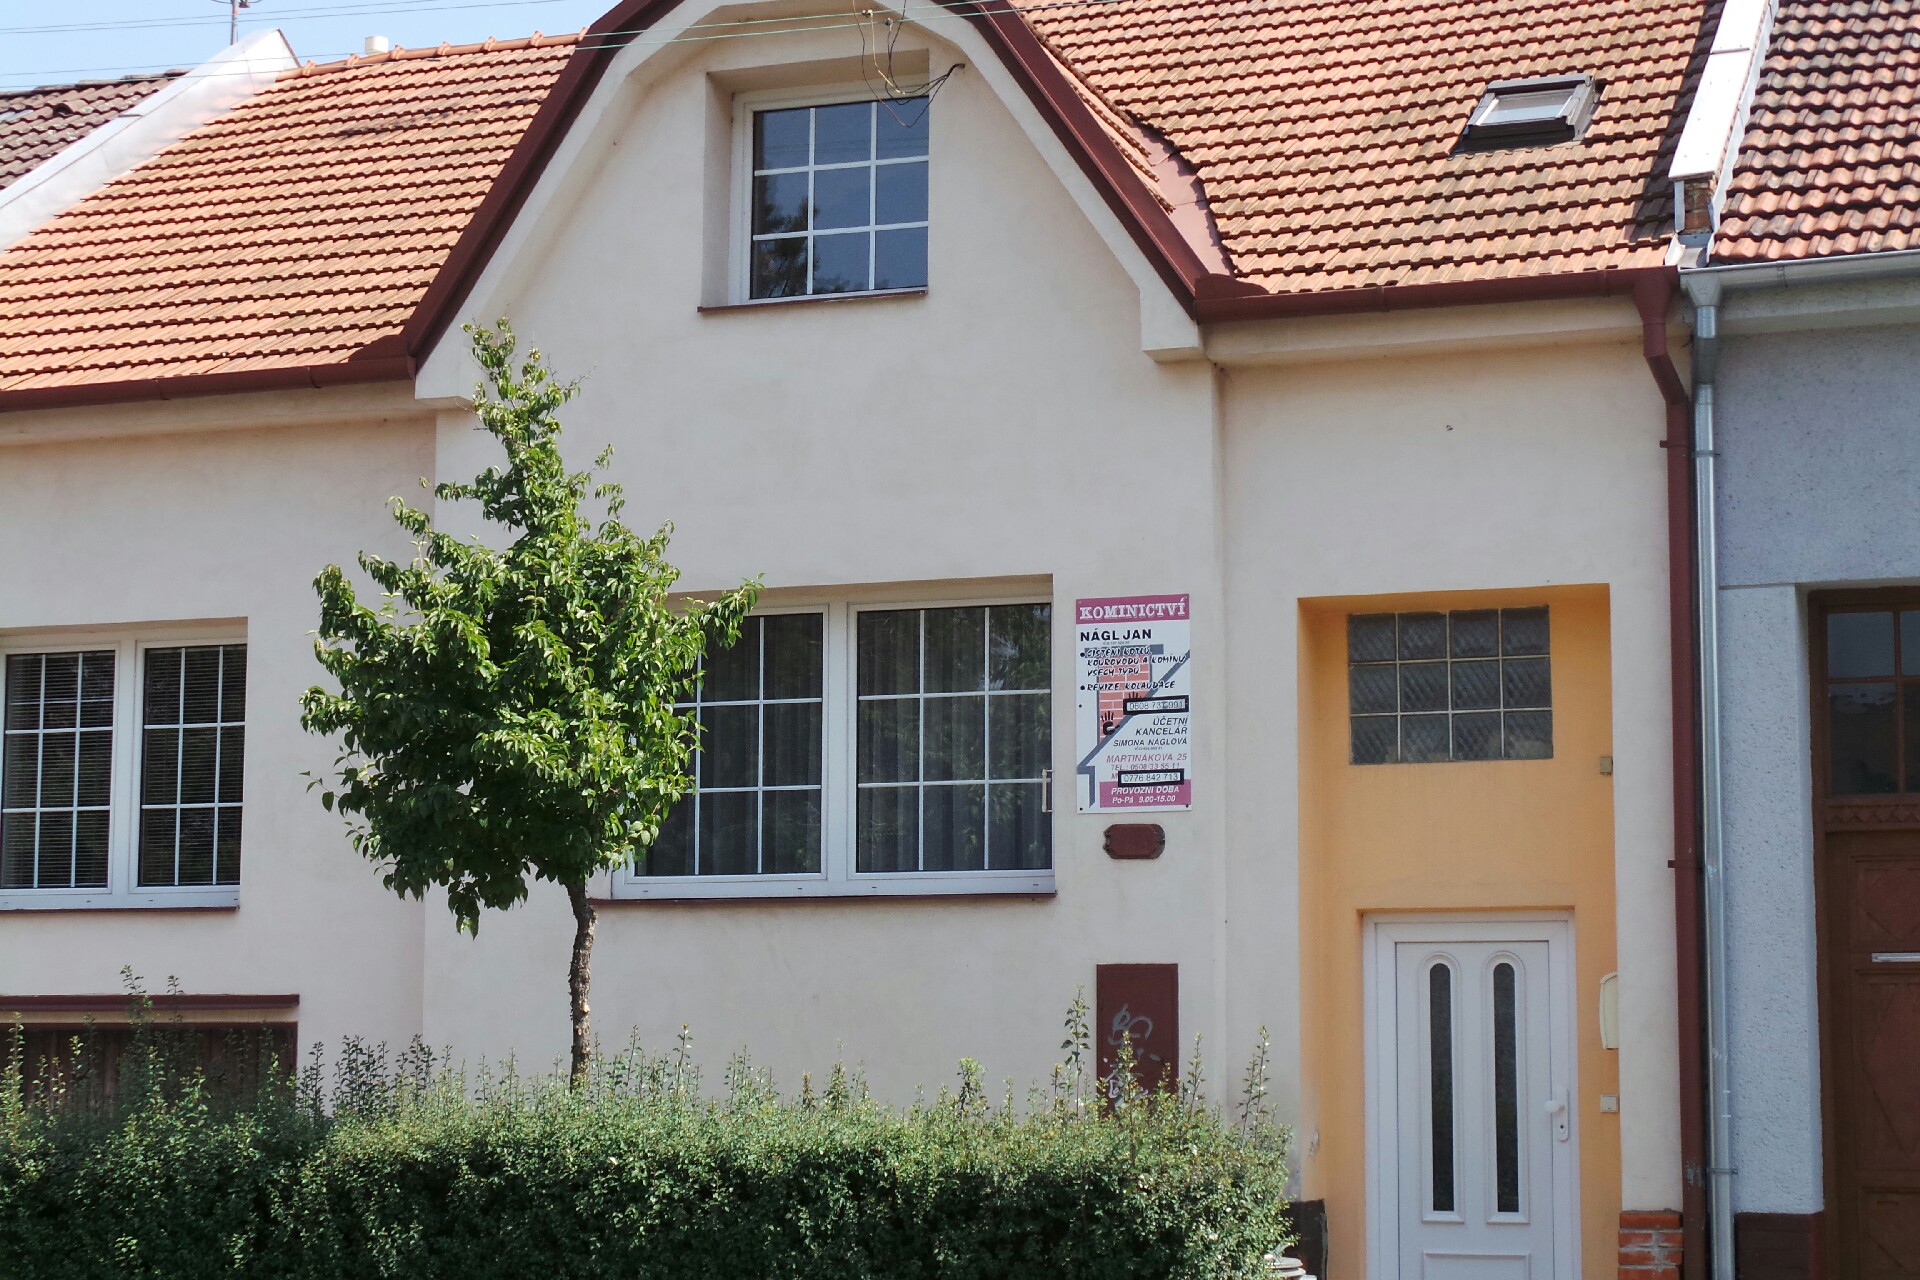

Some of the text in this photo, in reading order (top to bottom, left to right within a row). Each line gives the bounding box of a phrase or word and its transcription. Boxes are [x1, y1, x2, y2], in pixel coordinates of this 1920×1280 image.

[1080, 598, 1185, 619] KOMINICTVÍ
[1080, 628, 1152, 641] NÁGL JAN
[1142, 656, 1148, 664] A
[1087, 681, 1176, 691] REVIZE KOLAUDACE
[1152, 715, 1190, 726] ÚČETNÍ
[1113, 739, 1145, 747] SIMONA
[1106, 753, 1188, 763] MARTINÁKOVA 25
[1123, 774, 1144, 783] 0776
[1146, 773, 1161, 782] 842
[1164, 772, 1179, 781] 713
[1156, 785, 1180, 793] DOBA
